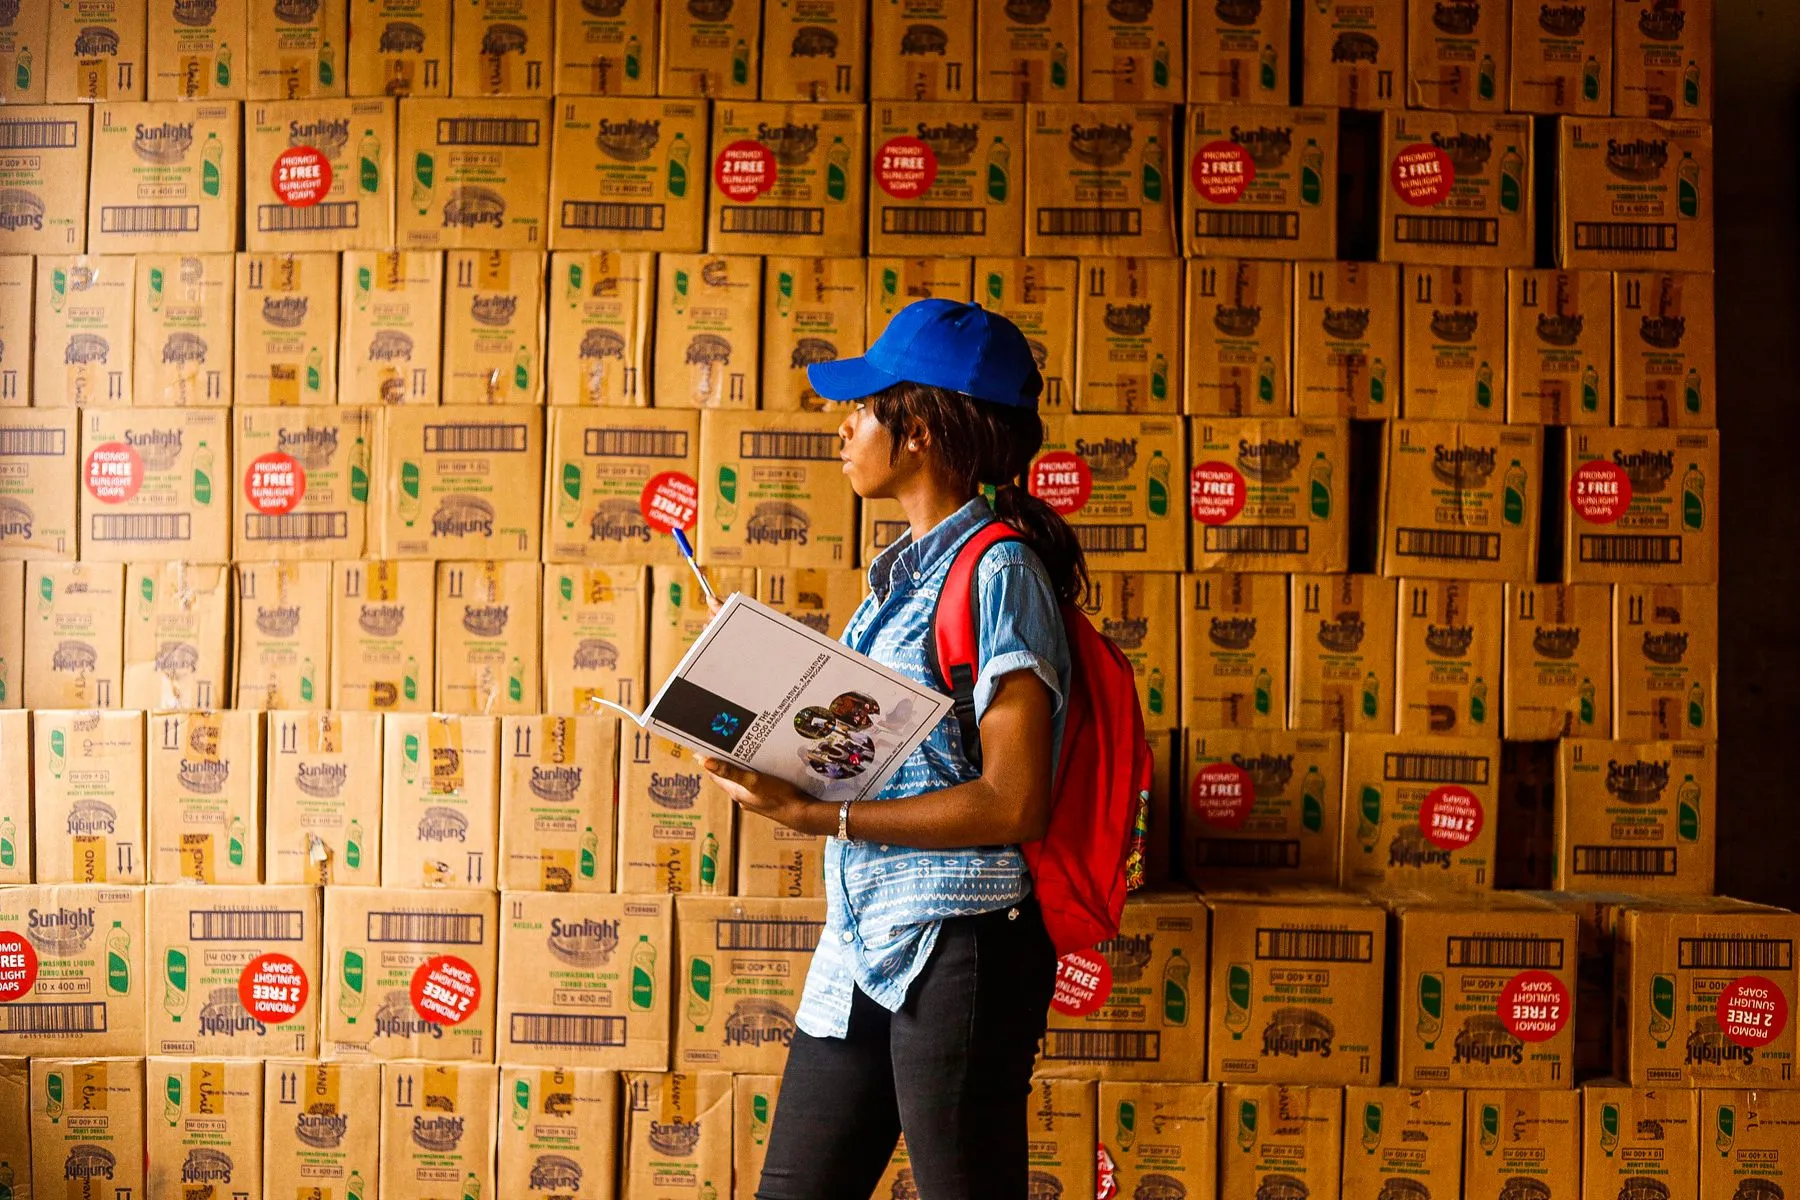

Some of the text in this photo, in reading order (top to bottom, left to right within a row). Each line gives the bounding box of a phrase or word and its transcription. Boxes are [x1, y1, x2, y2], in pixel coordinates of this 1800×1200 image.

[136, 120, 194, 141] Sunlight
[290, 120, 349, 140] Sunlight
[599, 118, 660, 139] Sunlight
[758, 121, 819, 142] Sunlight
[918, 122, 980, 142] Sunlight
[1072, 122, 1133, 142] Sunlight
[1230, 126, 1293, 145] Sunlight
[1431, 132, 1492, 152] Sunlight
[1608, 138, 1668, 158] Sunlight
[886, 147, 920, 155] PROMO!
[281, 156, 315, 166] PROMO!
[723, 160, 764, 173] 2 FREE
[882, 156, 924, 169] 2 FREE
[1201, 161, 1242, 174] 2 FREE
[1399, 160, 1440, 178] 2 FREE
[279, 165, 320, 181] 2 FREE
[280, 179, 321, 190] SUNLIGHT
[287, 190, 314, 200] SOAPS
[444, 210, 503, 228] Sunlight
[125, 430, 182, 447] Sunlight
[278, 426, 338, 448] Sunlight
[1076, 438, 1138, 458] Sunlight
[1239, 440, 1300, 458] Sunlight
[1434, 444, 1496, 466] Sunlight
[94, 452, 129, 461] PROMO!
[1613, 450, 1674, 470] Sunlight
[91, 462, 132, 476] 2 FREE
[255, 463, 291, 472] PROMO!
[1039, 462, 1076, 471] PROMO!
[90, 476, 132, 486] SUNLIGHT
[252, 472, 294, 487] 2 FREE
[1037, 472, 1079, 486] 2 FREE
[1197, 471, 1232, 480] PROMO!
[97, 485, 125, 496] SOAPS
[252, 487, 294, 497] SUNLIGHT
[1191, 481, 1235, 496] 2 FREE
[1577, 481, 1618, 494] 2 FREE
[260, 497, 287, 506] SOAPS
[651, 494, 693, 521] 2 FREE
[433, 519, 492, 538] Sunlight
[591, 524, 650, 542] Sunlight
[746, 525, 807, 544] Sunlight
[770, 702, 792, 730] DEVELOPMENT
[791, 678, 812, 704] FOUNDATION
[810, 655, 831, 680] PROGRAMME
[741, 740, 758, 761] LAGOS
[754, 725, 769, 741] FOOD
[766, 710, 780, 727] BANK
[778, 684, 800, 710] INITIATIVE
[800, 652, 826, 683] PALLIATIVES
[734, 710, 771, 758] REPORT OF THE
[180, 758, 230, 774] Sunlight
[299, 763, 346, 778] Sunlight
[532, 766, 582, 782] Sunlight
[1608, 760, 1670, 779] Sunlight
[651, 772, 702, 790] Sunlight
[1200, 783, 1241, 796] 2 FREE
[68, 820, 115, 834] Sunlight
[1432, 813, 1474, 832] 2 FREE
[418, 828, 465, 842] Sunlight
[28, 908, 95, 930] Sunlight
[552, 918, 620, 941] Sunlight
[262, 962, 293, 974] SOAPS
[442, 963, 472, 983] SOAPS
[748, 962, 764, 972] 400
[776, 963, 787, 972] 10
[38, 982, 47, 990] 10
[58, 982, 74, 990] 400
[78, 982, 89, 990] ml
[253, 972, 301, 986] SUNLIGHT
[428, 970, 475, 997] SUNLIGHT
[1064, 966, 1100, 990] FREE
[1695, 981, 1706, 990] ml
[252, 984, 300, 1002] 2 FREE
[1521, 982, 1552, 991] SOAPS
[1738, 987, 1768, 998] SOAPS
[422, 981, 470, 1011] 2 FREE
[1513, 993, 1560, 1003] SUNLIGHT
[1728, 997, 1775, 1011] SUNLIGHT
[255, 1001, 296, 1013] PROMO!
[420, 997, 461, 1021] PROMO!
[1513, 1005, 1559, 1019] 2 FREE
[200, 1014, 266, 1036] Sunlight
[1516, 1021, 1556, 1031] PROMO!
[1727, 1009, 1773, 1027] 2 FREE
[375, 1017, 442, 1039] Sunlight
[724, 1024, 793, 1047] Sunlight
[1728, 1025, 1768, 1038] PROMO!
[1261, 1037, 1331, 1057] Sunlight
[1452, 1041, 1524, 1064] Sunlight
[1684, 1043, 1754, 1065] Sunlight
[298, 1113, 347, 1130] Sunlight
[414, 1116, 464, 1132] Sunlight
[650, 1121, 700, 1137] Sunlight
[64, 1164, 114, 1182] Sunlight
[182, 1168, 230, 1184] Sunlight
[530, 1177, 579, 1191] Sunlight
